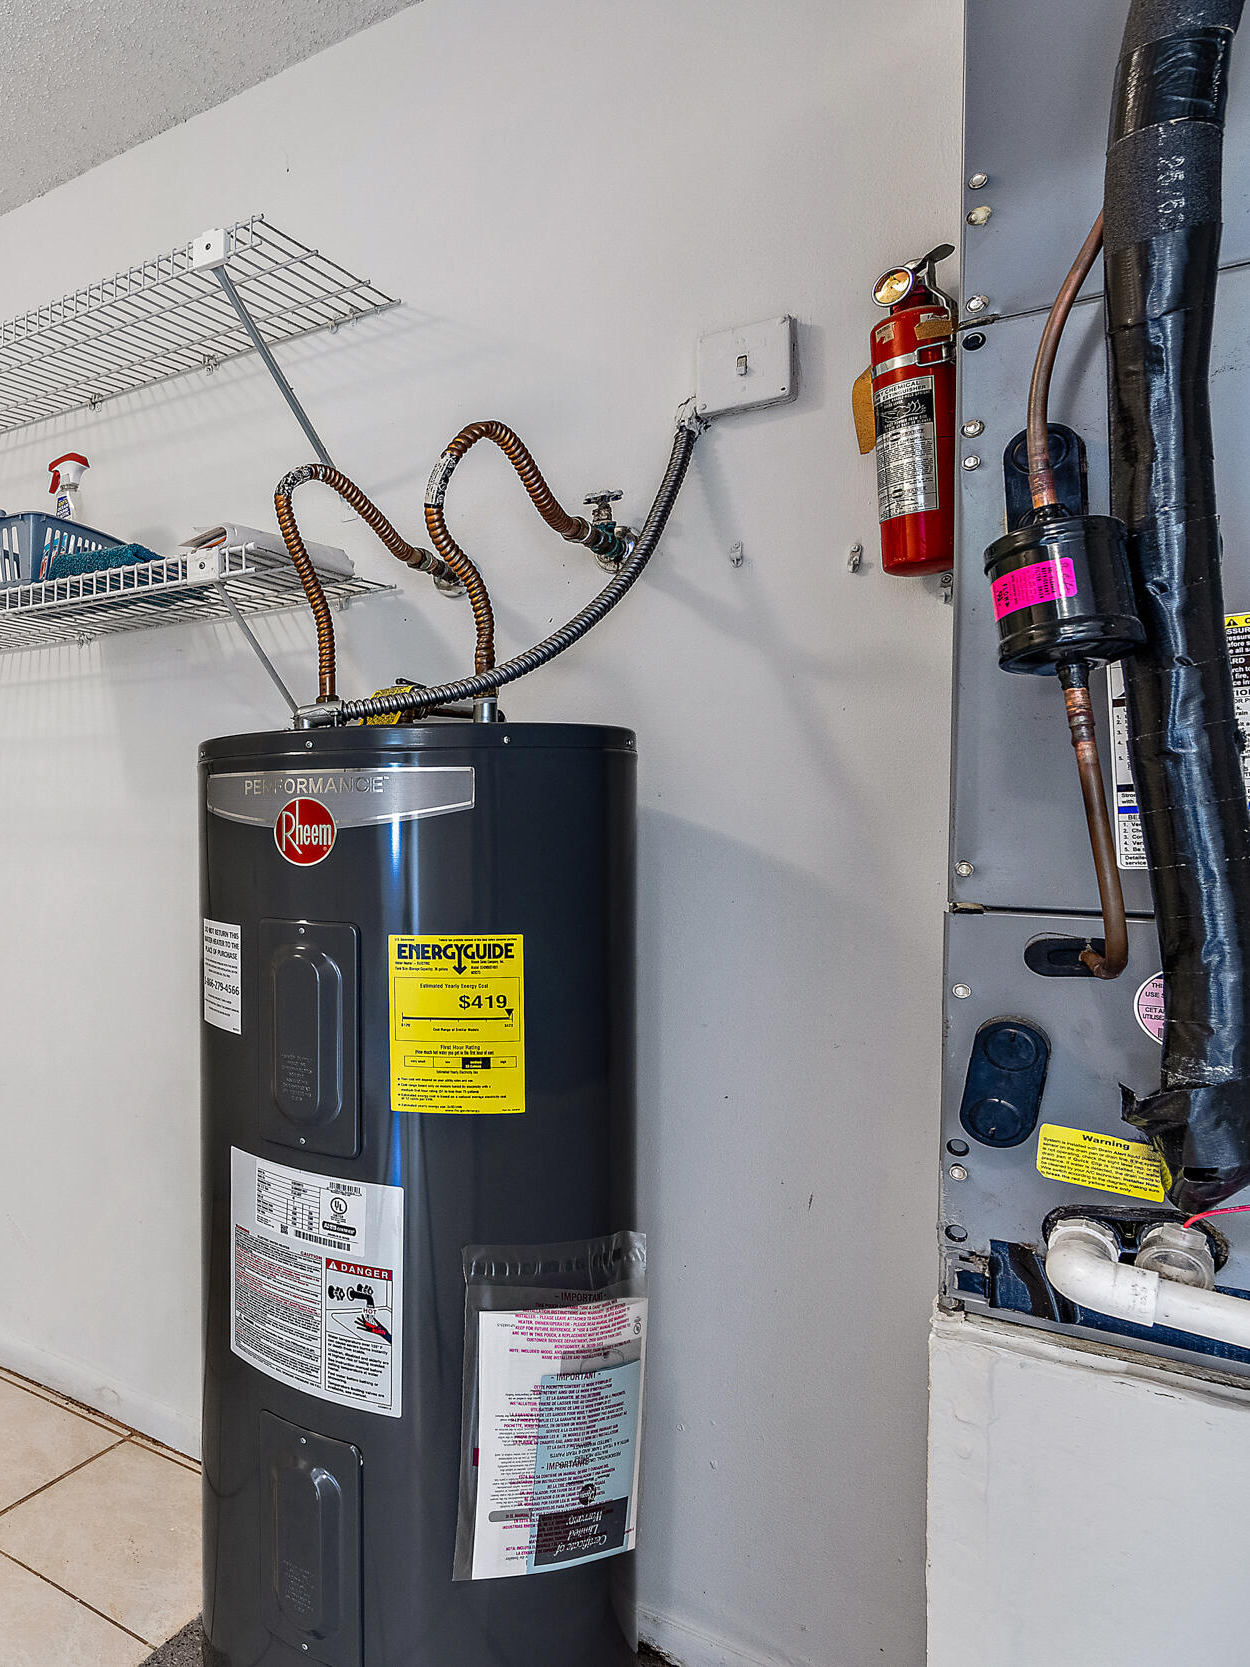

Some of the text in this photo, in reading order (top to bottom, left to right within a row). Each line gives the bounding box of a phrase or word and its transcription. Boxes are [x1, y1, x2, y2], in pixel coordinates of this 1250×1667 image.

[885, 380, 921, 394] CHEMICAL
[281, 800, 332, 854] Rheem
[215, 928, 229, 938] RETURN
[229, 931, 239, 940] THIS
[213, 937, 224, 947] HEATER
[224, 940, 231, 948] TO
[231, 942, 239, 950] THE
[217, 948, 237, 960] PURCHASE
[398, 943, 514, 960] ENERGYGUIDE
[458, 995, 507, 1010] $419
[1082, 1134, 1130, 1150] Warning
[300, 1250, 322, 1260] CAUTION
[341, 1263, 389, 1279] DANGER
[561, 1292, 603, 1302] IMPORTANT
[556, 1372, 596, 1381] IMPORTANT
[568, 1510, 603, 1525] Warranty
[567, 1524, 599, 1541] Limited
[553, 1534, 607, 1556] Certificate of
